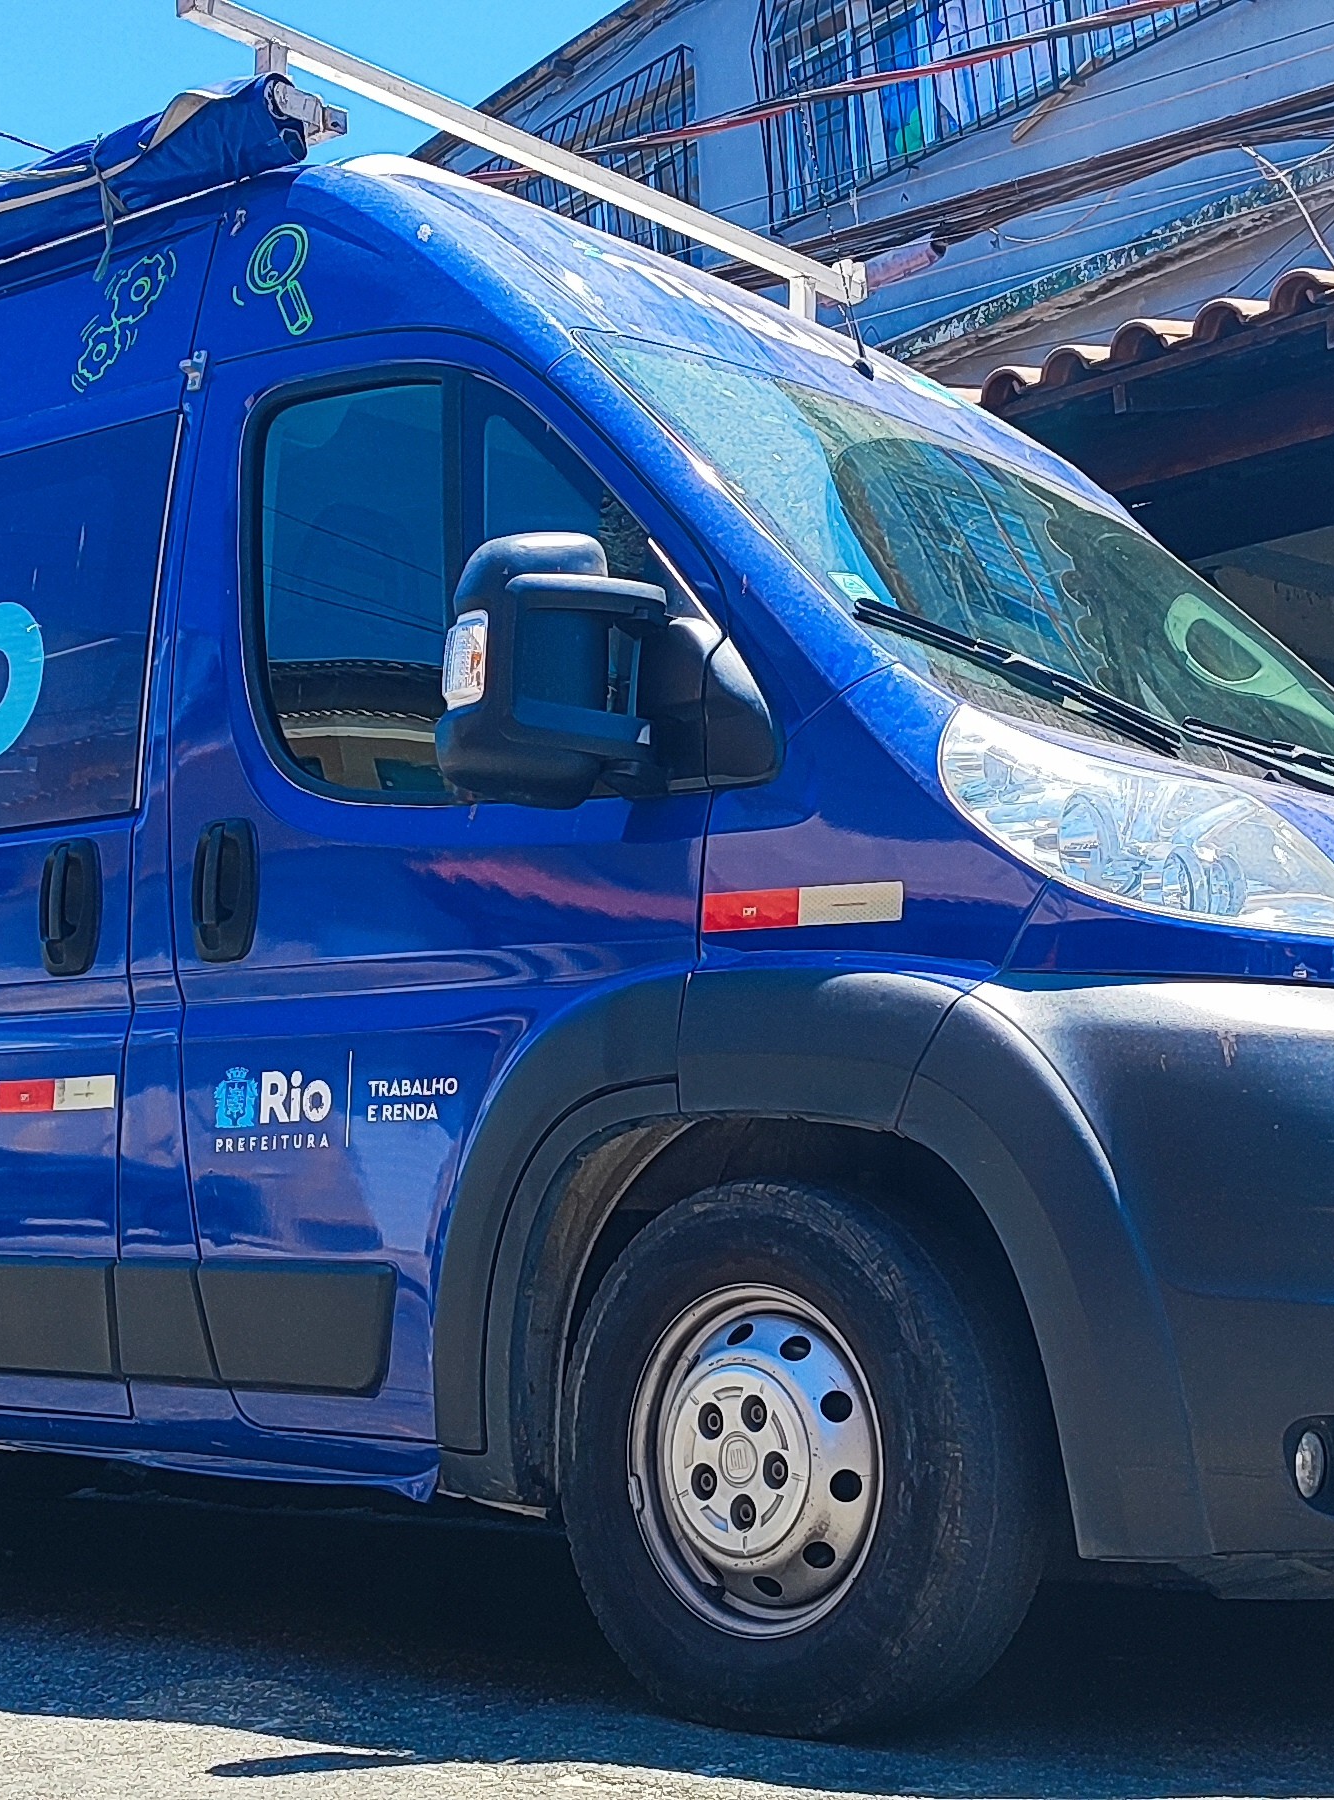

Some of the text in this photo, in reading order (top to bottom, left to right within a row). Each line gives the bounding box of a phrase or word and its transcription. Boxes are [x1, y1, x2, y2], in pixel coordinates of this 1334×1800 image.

[368, 1077, 458, 1097] TRABALHO
[260, 1070, 332, 1125] Rio
[368, 1102, 438, 1122] E RENDA
[215, 1133, 330, 1153] PREFEITURA
